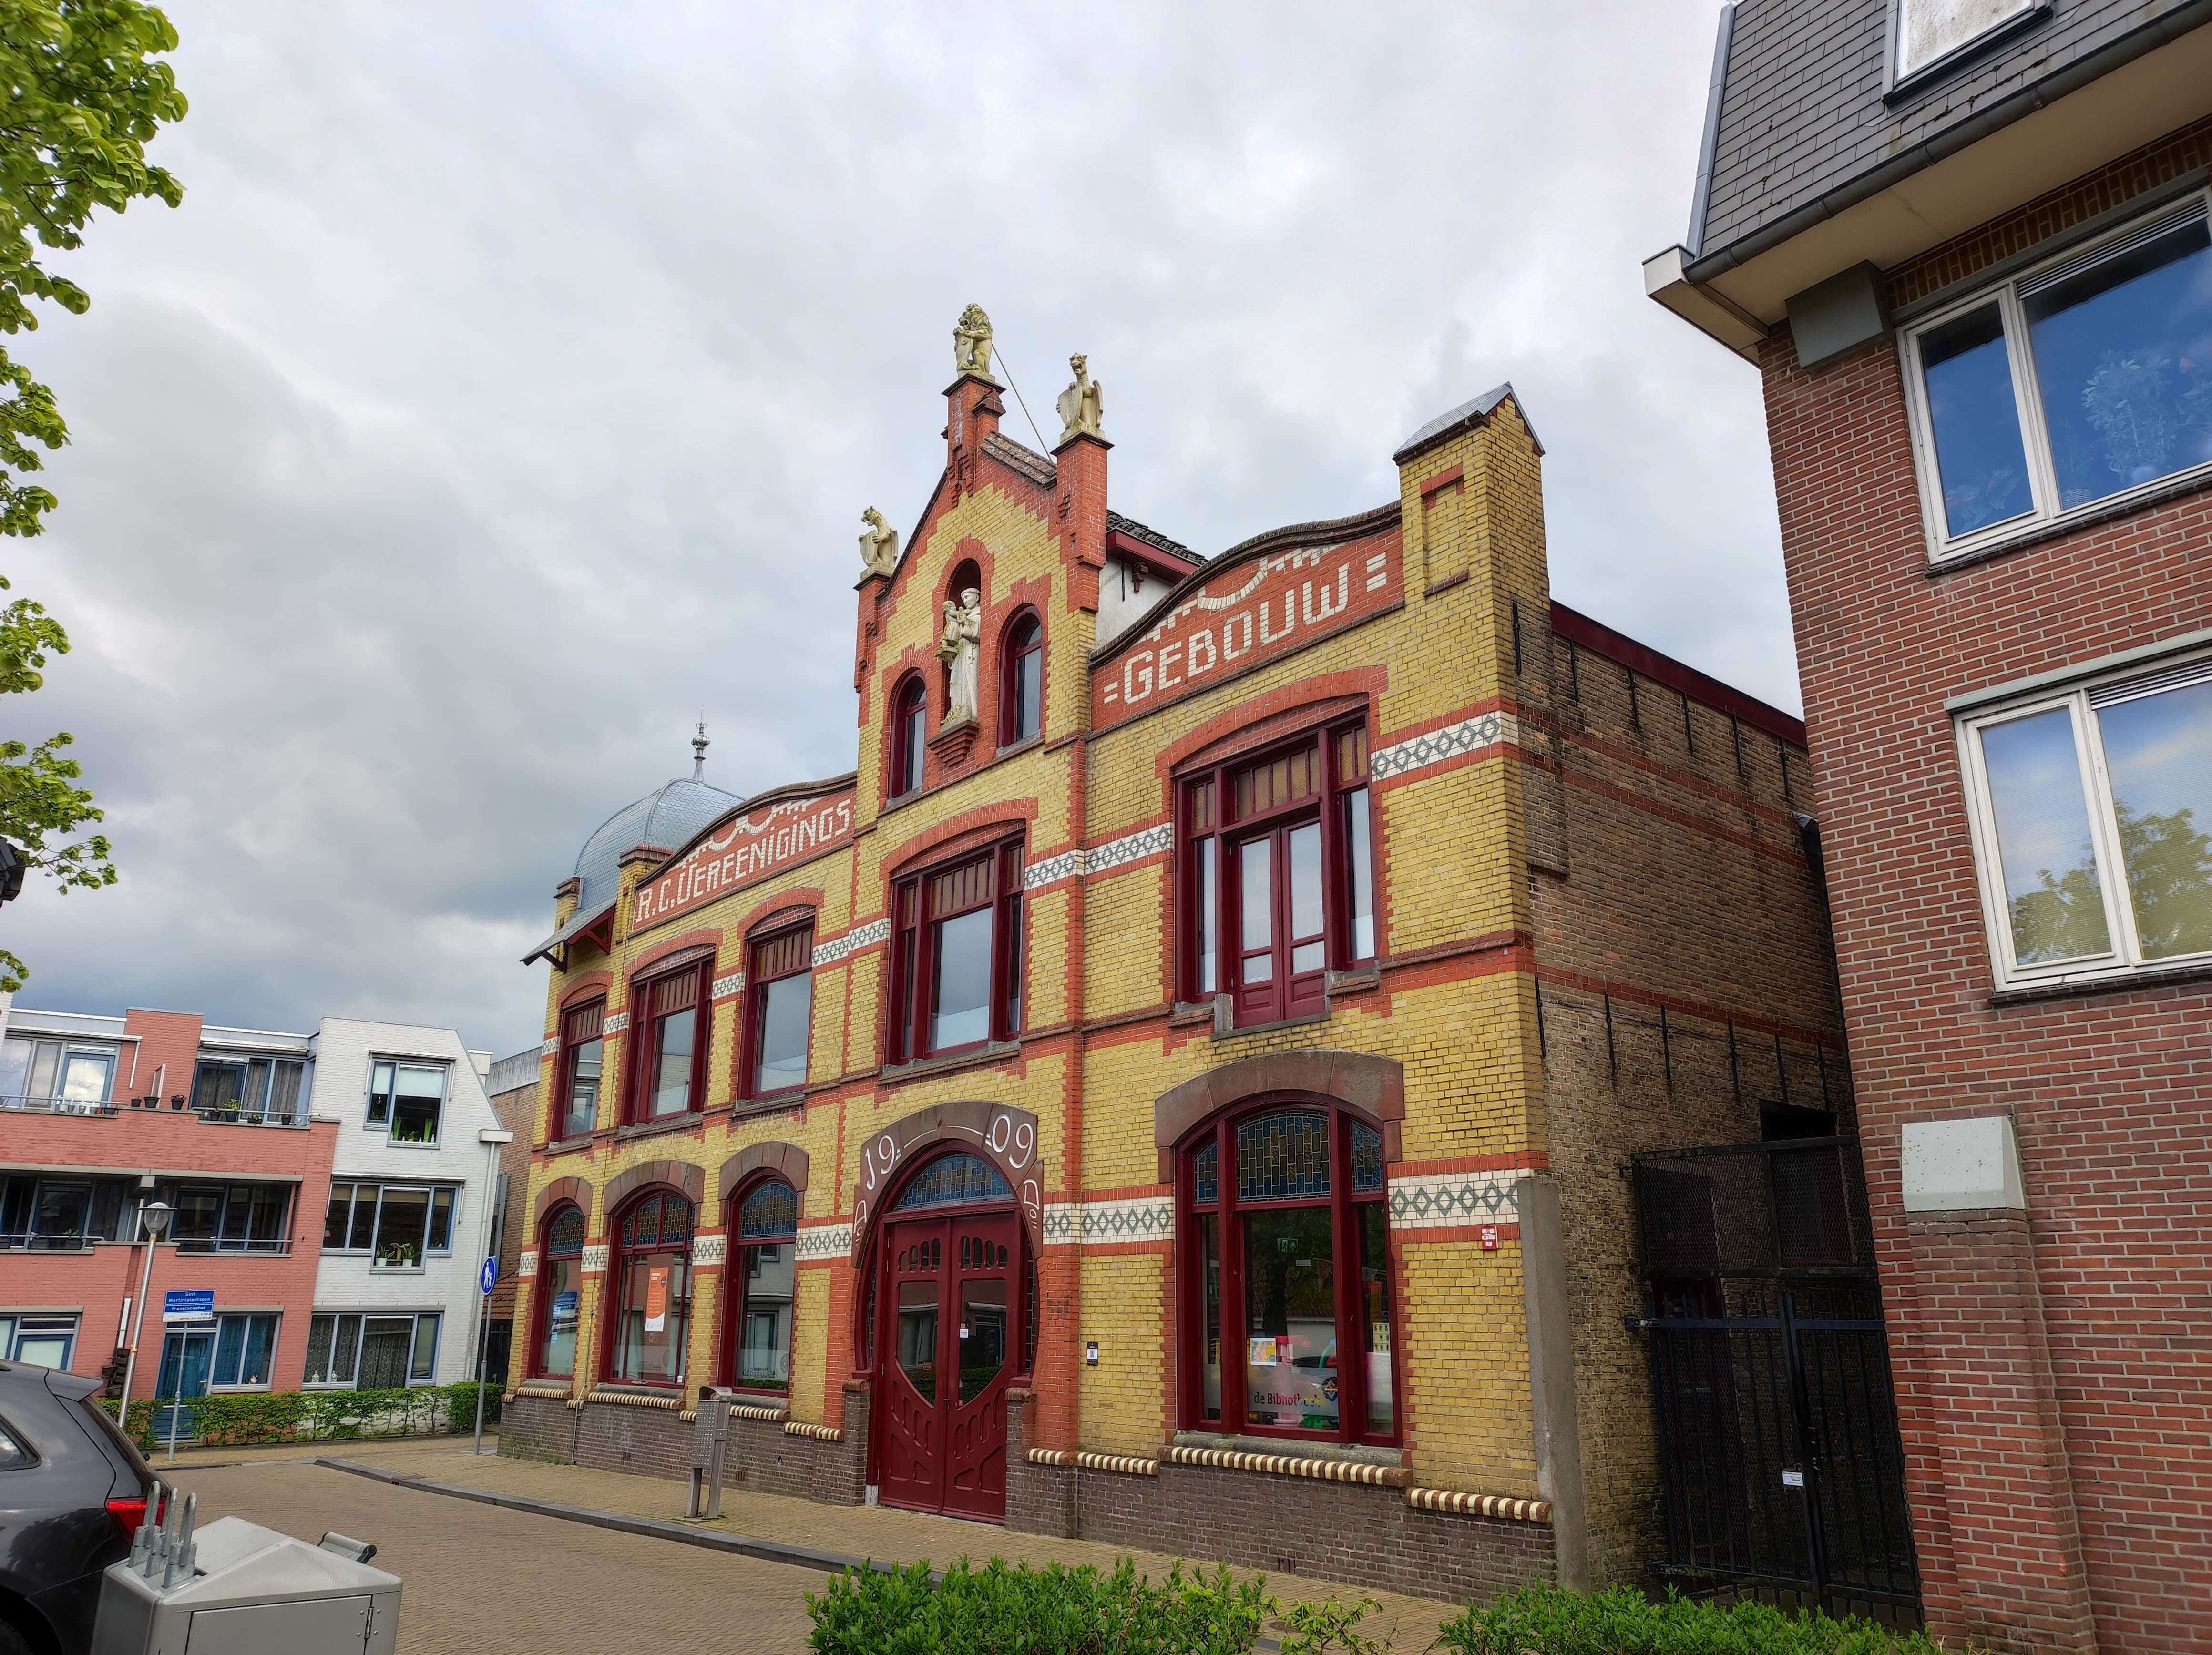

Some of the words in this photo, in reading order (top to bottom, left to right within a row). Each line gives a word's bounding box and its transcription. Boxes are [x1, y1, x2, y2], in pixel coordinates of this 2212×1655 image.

[743, 1366, 749, 1377] de
[1254, 1391, 1265, 1404] de
[1267, 1393, 1321, 1407] Bibliotheek
